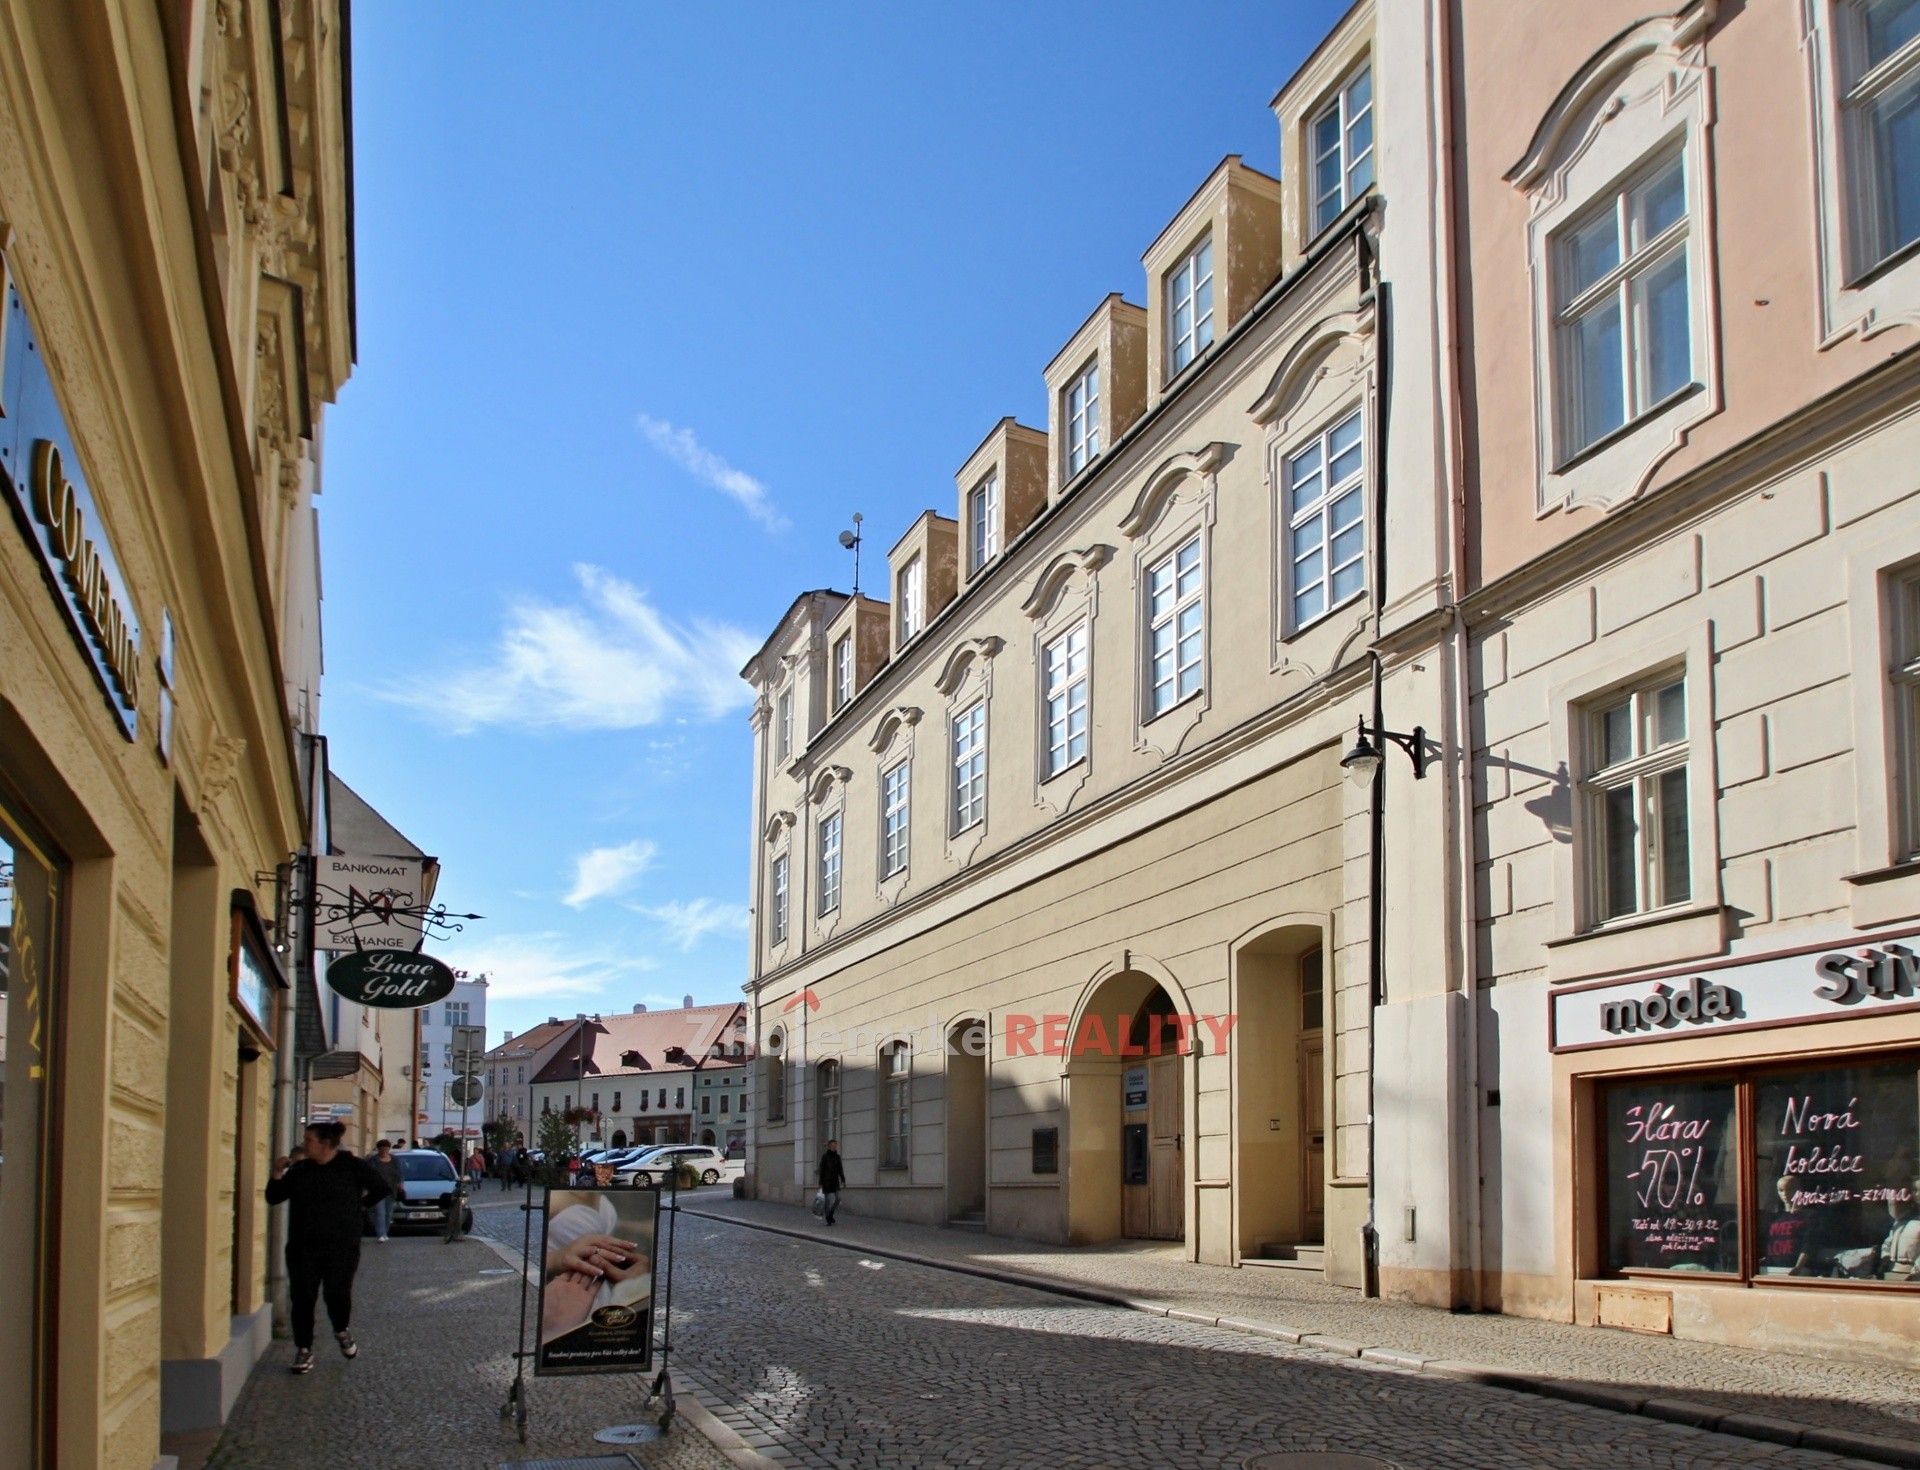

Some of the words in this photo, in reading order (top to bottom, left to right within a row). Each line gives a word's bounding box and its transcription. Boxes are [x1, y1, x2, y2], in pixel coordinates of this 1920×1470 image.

[33, 438, 140, 711] COMENIUS
[332, 862, 407, 876] BANKOMAT
[332, 933, 404, 947] EXCHANGE
[363, 953, 434, 976] Lucie
[360, 975, 429, 1001] Gold
[1600, 976, 1733, 1032] móda
[1781, 1096, 1861, 1135] Nová
[1783, 1145, 1864, 1176] kolekce
[1626, 1145, 1704, 1208] -50%
